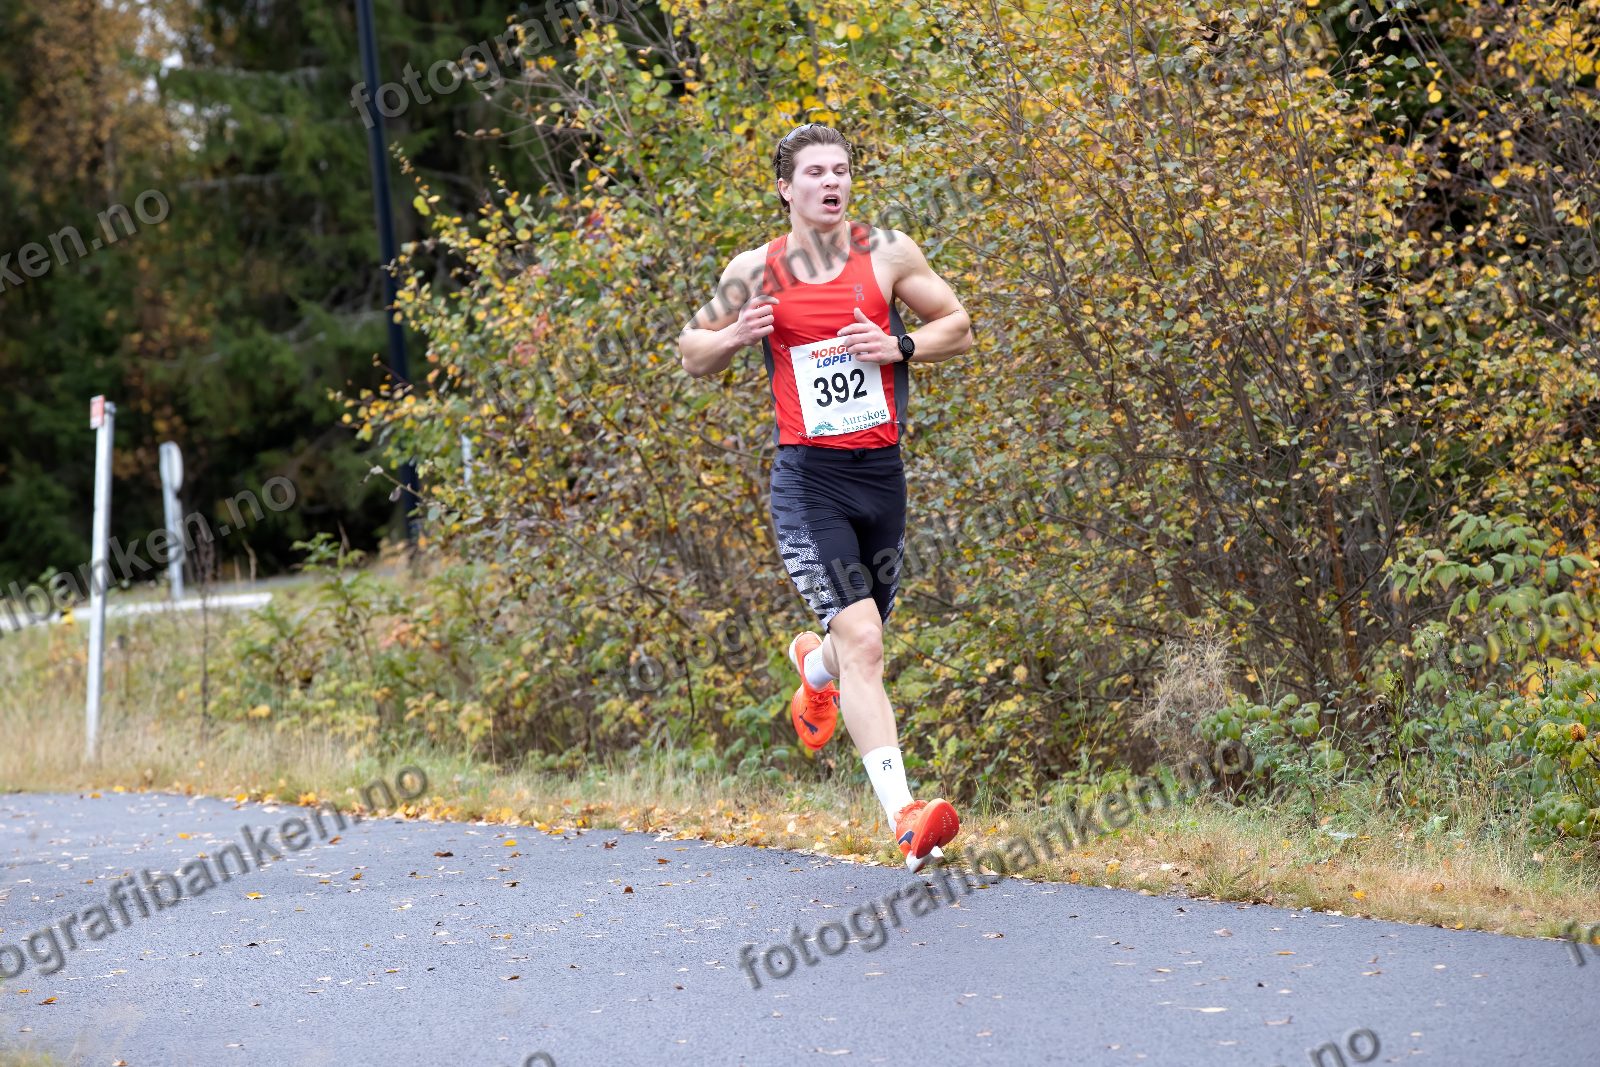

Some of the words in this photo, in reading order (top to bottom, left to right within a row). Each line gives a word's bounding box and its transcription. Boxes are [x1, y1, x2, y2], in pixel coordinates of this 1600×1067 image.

[811, 344, 849, 359] NORG
[817, 352, 853, 368] LØPET
[814, 368, 867, 407] 392
[842, 409, 887, 427] Aurskog
